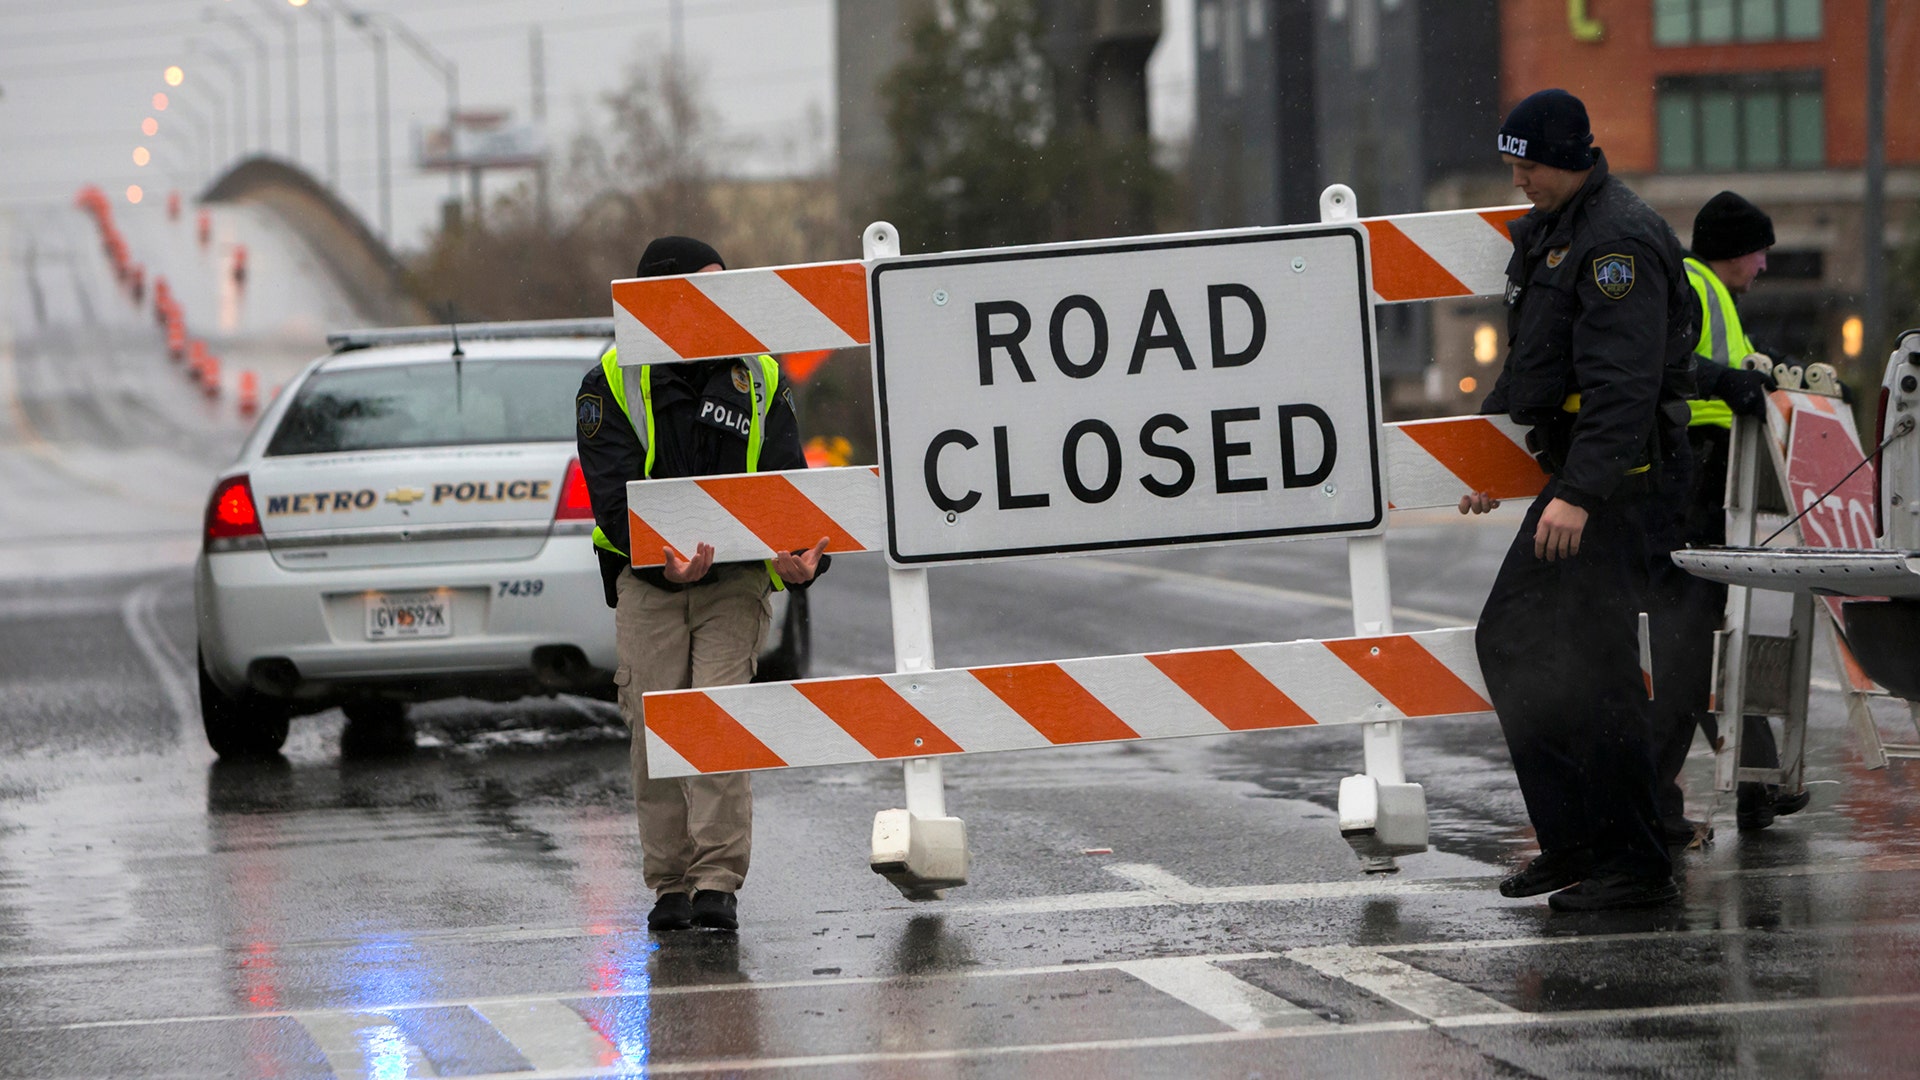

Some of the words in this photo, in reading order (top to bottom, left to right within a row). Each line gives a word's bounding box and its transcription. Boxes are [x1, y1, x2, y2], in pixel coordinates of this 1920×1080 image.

[1497, 133, 1528, 158] LICE
[974, 283, 1267, 386] ROAD
[700, 400, 751, 435] POLIC
[924, 403, 1338, 514] CLOSED
[266, 488, 378, 518] METRO
[431, 479, 553, 506] POLICE
[1802, 488, 1876, 549] STO
[497, 579, 544, 598] 7439
